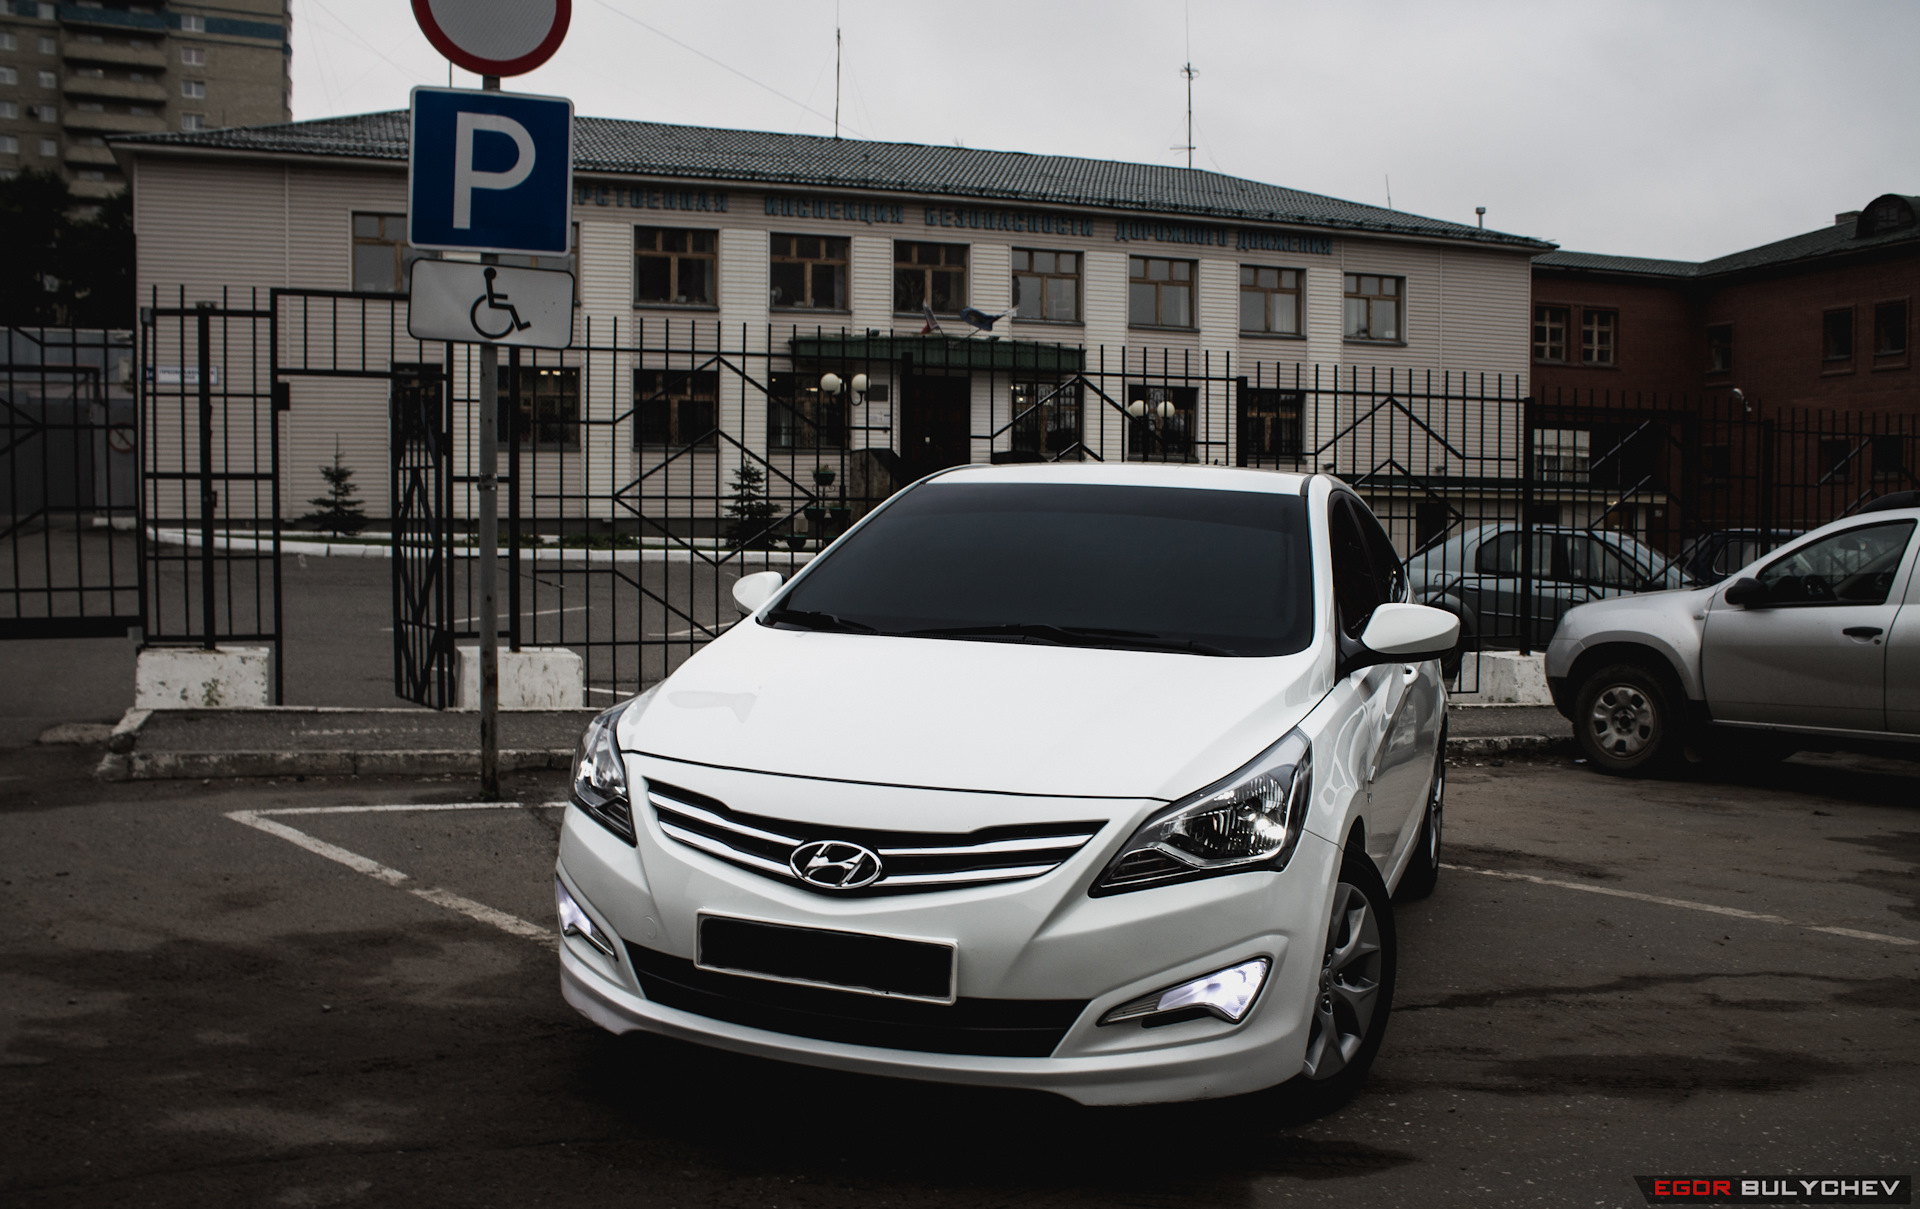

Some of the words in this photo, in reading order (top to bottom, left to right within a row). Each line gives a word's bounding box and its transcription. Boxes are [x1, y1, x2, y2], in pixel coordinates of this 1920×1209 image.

[452, 111, 536, 229] P
[572, 185, 728, 212] РСТВЕННАЯ
[765, 196, 904, 224] ИНСПЕКЦИЯ
[925, 206, 1094, 237] БЕЗОПАСНОСТИ
[1115, 221, 1229, 247] ДОРОЖНОГО
[1236, 230, 1333, 256] ДВИЖЕНИЯ
